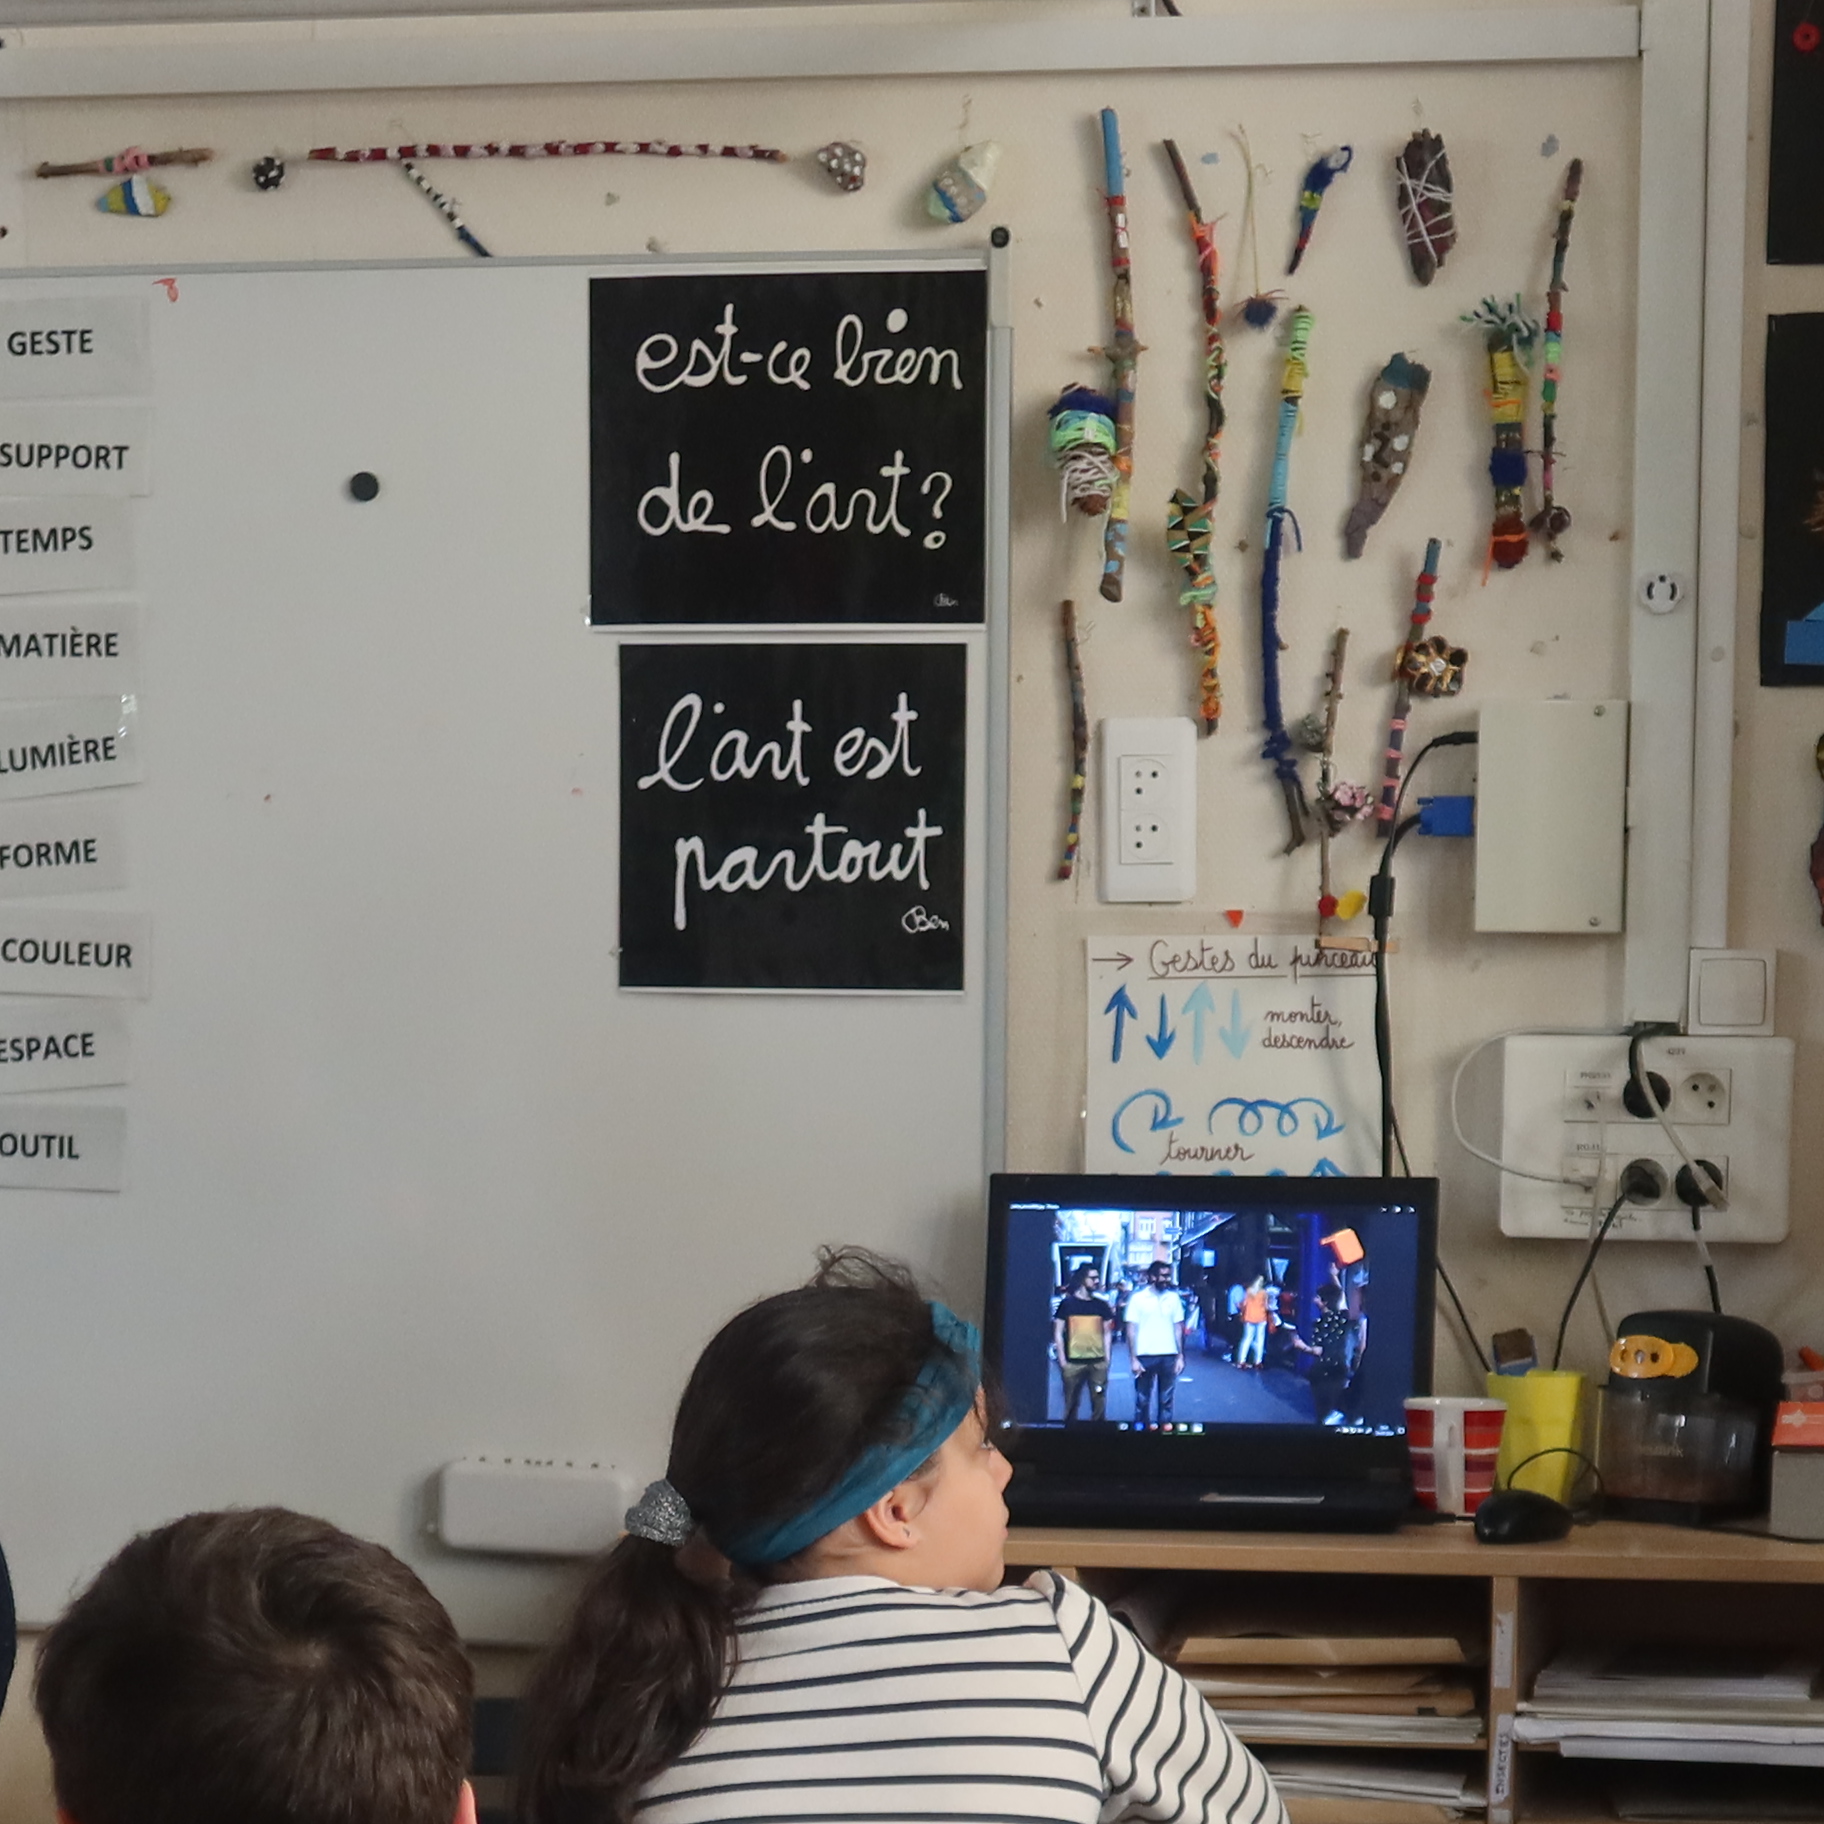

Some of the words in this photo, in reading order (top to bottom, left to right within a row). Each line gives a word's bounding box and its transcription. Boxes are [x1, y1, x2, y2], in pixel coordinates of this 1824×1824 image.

[7, 329, 94, 356] GESTE
[636, 302, 811, 393] est-ce
[833, 307, 964, 390] bien
[637, 451, 732, 536] de
[637, 692, 812, 791] l'art
[834, 691, 922, 780] est
[0, 838, 97, 869] FORME
[674, 808, 944, 931] partout
[1, 937, 133, 968] COULEUR
[1148, 939, 1236, 974] Gestes
[1248, 937, 1279, 969] du
[1263, 996, 1343, 1027] monter,
[1262, 1027, 1354, 1050] descendre
[1160, 1130, 1255, 1165] tourner
